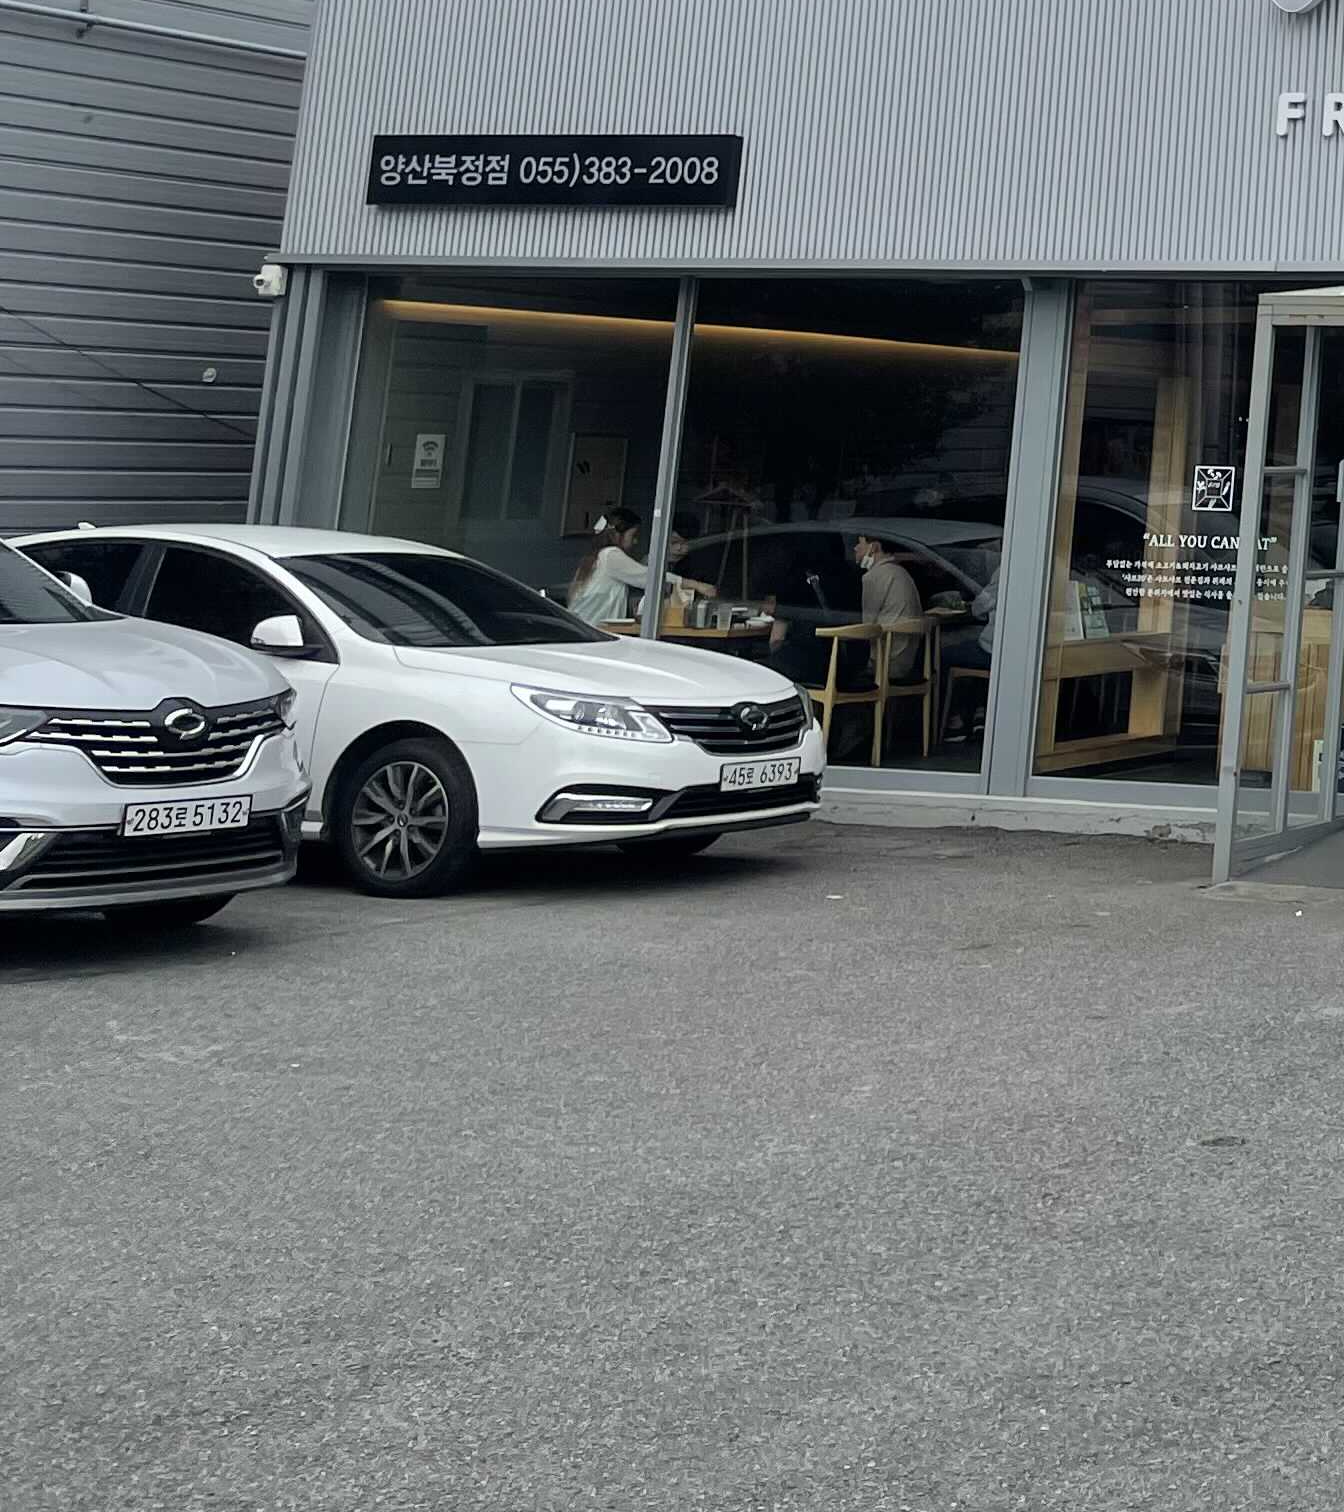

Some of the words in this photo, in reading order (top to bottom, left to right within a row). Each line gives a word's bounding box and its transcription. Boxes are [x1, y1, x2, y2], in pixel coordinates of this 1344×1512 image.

[379, 153, 511, 186] 양산북정점
[519, 153, 720, 188] 055)383-2008
[1178, 535, 1209, 549] YOU
[1211, 536, 1240, 550] CAN
[728, 767, 755, 786] 45로
[760, 762, 793, 784] 6393
[132, 807, 189, 832] 283로
[192, 801, 243, 827] 5132
